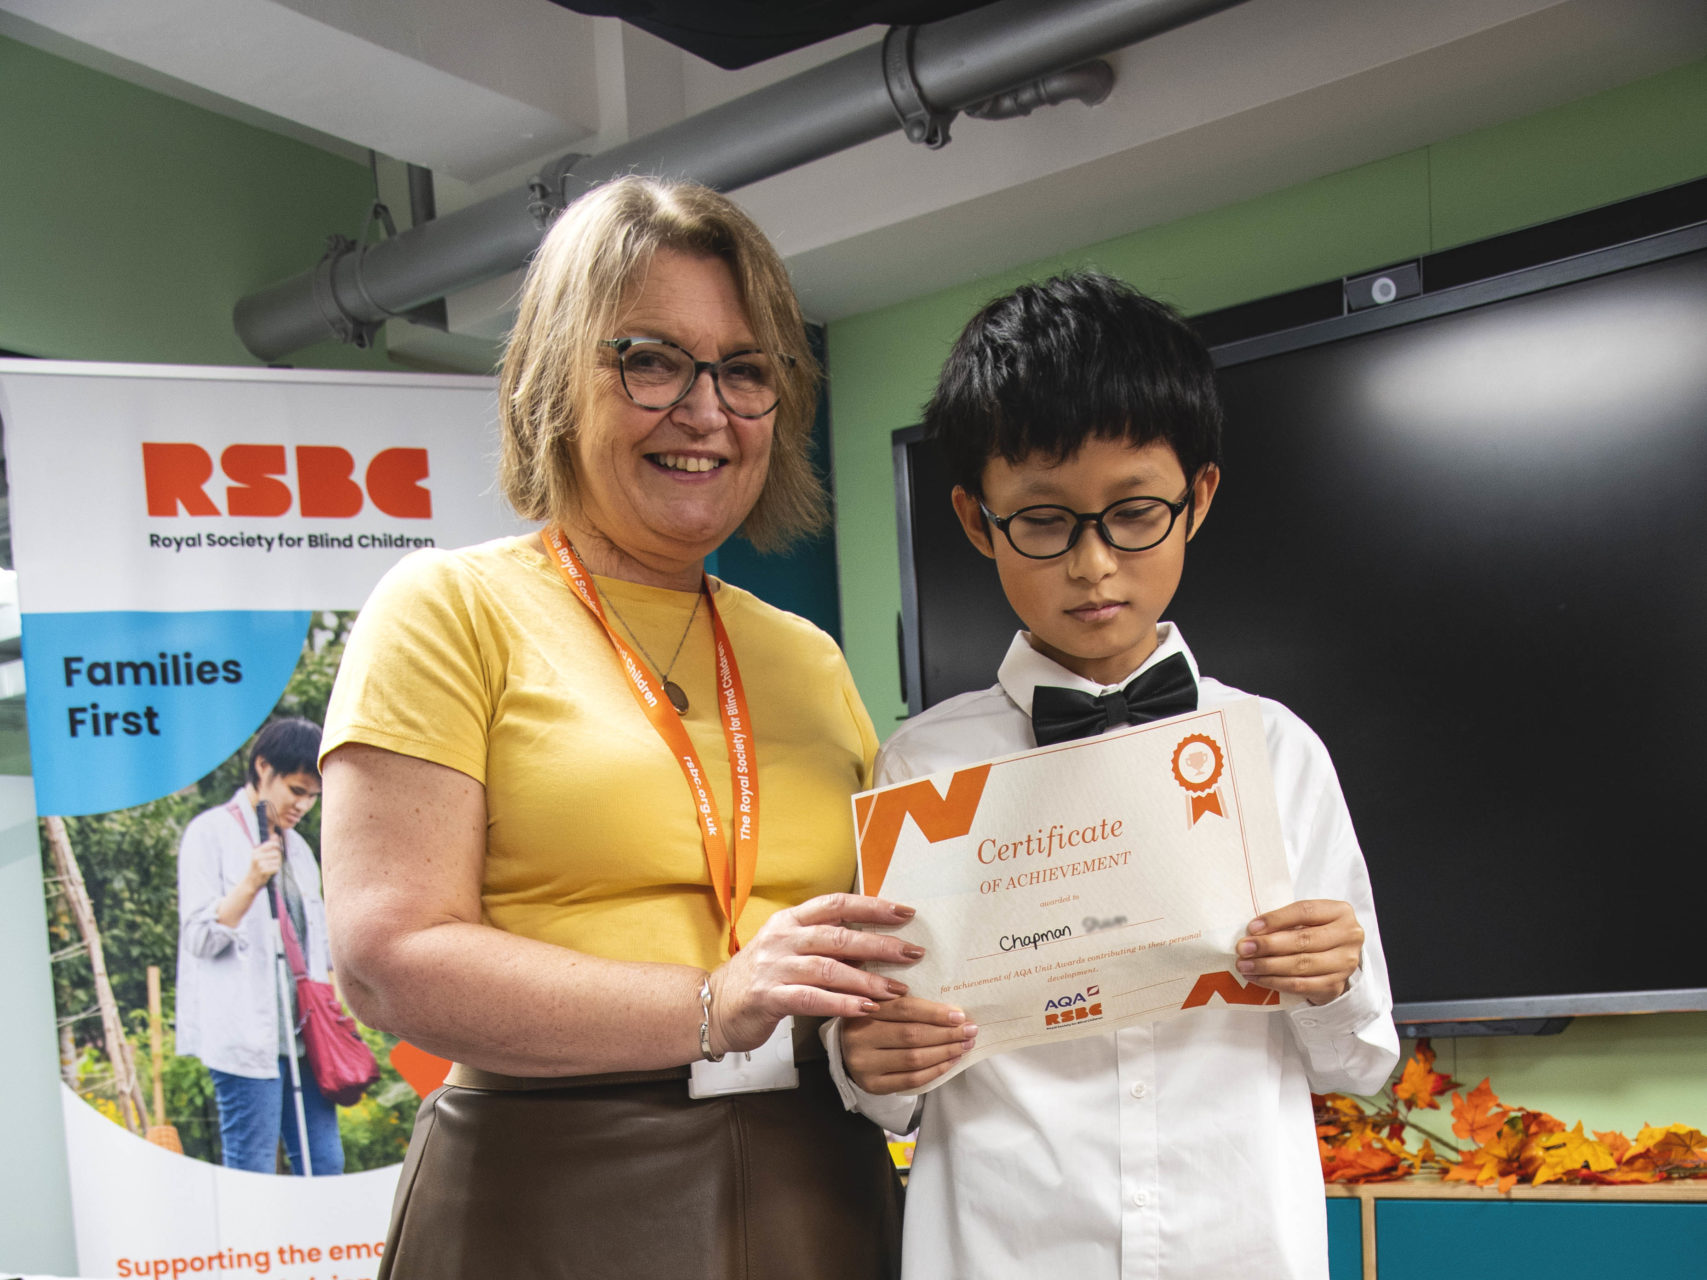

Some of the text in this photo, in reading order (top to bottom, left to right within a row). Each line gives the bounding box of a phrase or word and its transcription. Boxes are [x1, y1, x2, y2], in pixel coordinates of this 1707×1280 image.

[142, 441, 433, 520] RSBC
[149, 533, 435, 553] Royal Society for Blind Children
[556, 547, 583, 579] Royal
[626, 657, 658, 708] Children
[63, 651, 243, 688] Families
[68, 702, 161, 738] First
[717, 640, 754, 841] The Royal Society for Blind Children
[683, 755, 718, 837] rsbc.org.uk
[977, 818, 1124, 865] Certificate
[979, 850, 1132, 895] OF ACHIEVEMENT
[1039, 895, 1071, 908] awarded
[999, 925, 1072, 952] Chapman
[940, 985, 951, 994] for
[953, 975, 1002, 990] achievement
[1003, 972, 1012, 981] of
[1013, 967, 1033, 979] AQA
[1034, 964, 1053, 974] Unit
[1055, 956, 1086, 970] Awards
[1087, 946, 1137, 962] contributing
[1148, 941, 1166, 949] their
[1168, 930, 1202, 947] personal
[1047, 967, 1099, 984] development.
[1044, 992, 1087, 1012] AQA
[1045, 1002, 1103, 1027] RSBC
[277, 1244, 322, 1265] the
